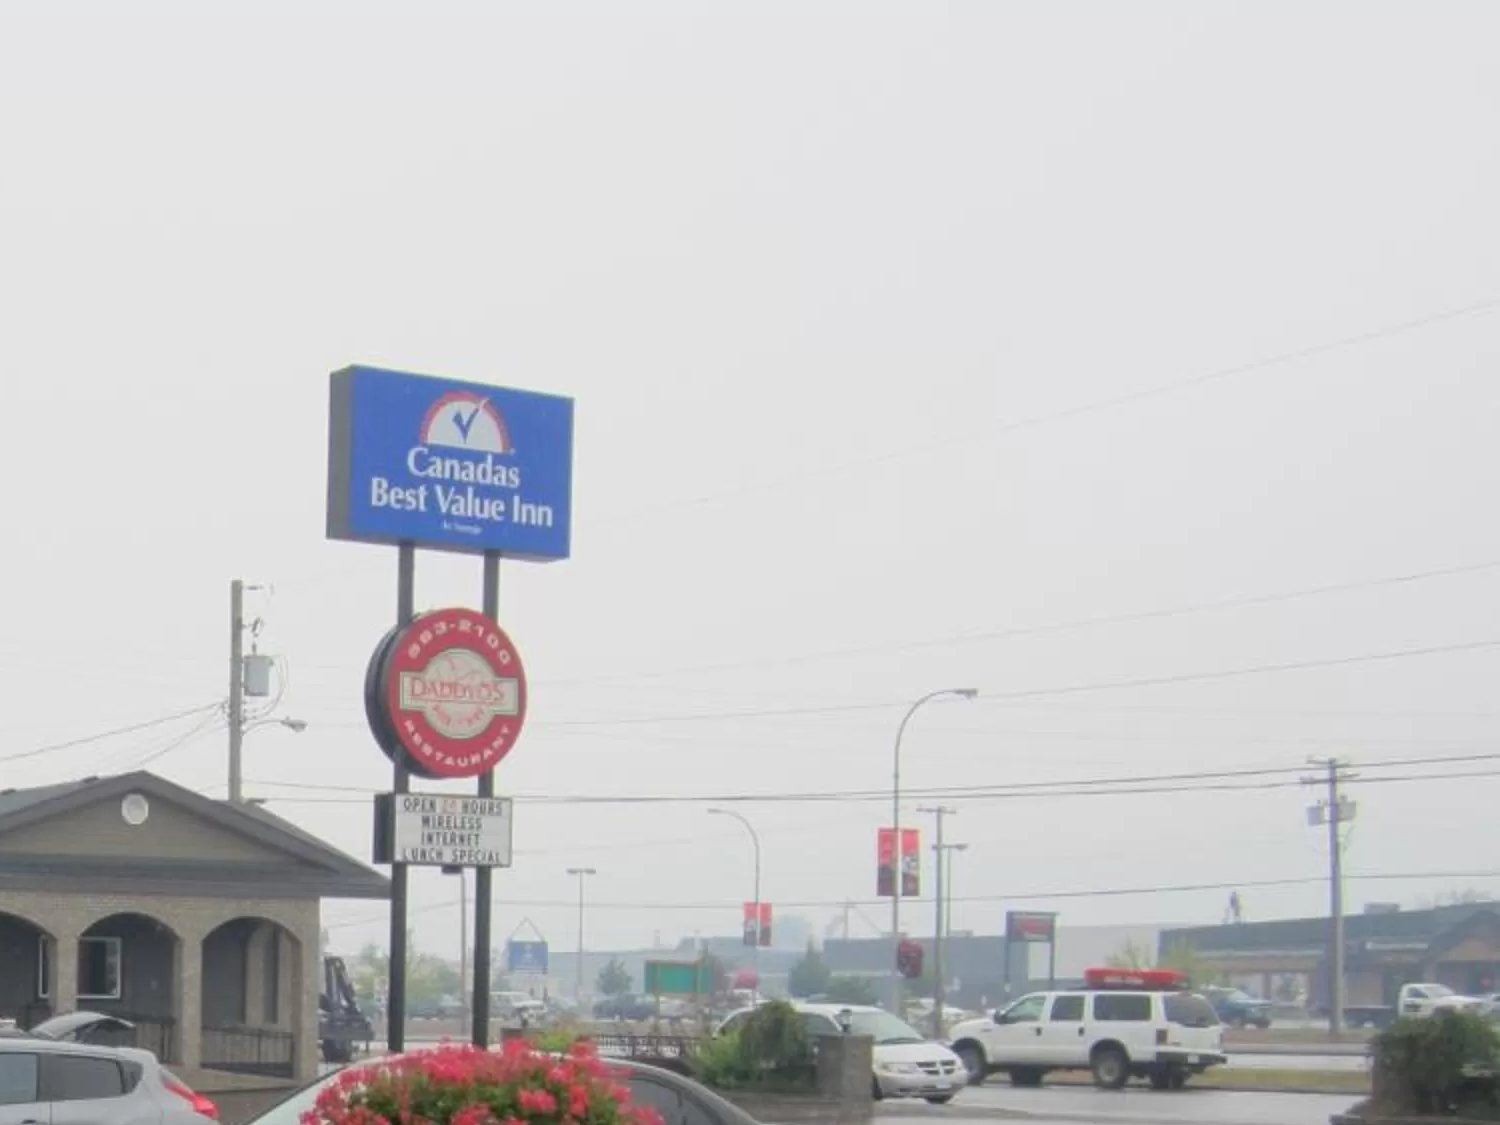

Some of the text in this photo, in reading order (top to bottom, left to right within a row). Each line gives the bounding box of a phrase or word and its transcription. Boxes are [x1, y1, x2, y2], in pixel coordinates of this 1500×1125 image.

[407, 446, 521, 489] Canadas
[370, 477, 428, 512] Best
[434, 484, 506, 522] Value
[511, 496, 553, 528] Inn
[404, 719, 510, 768] RESTAURANT
[403, 797, 437, 813] OPEN
[461, 799, 502, 816] HOURS
[420, 831, 480, 847] INTERNET
[403, 847, 501, 864] LUNCH SPECIAL
